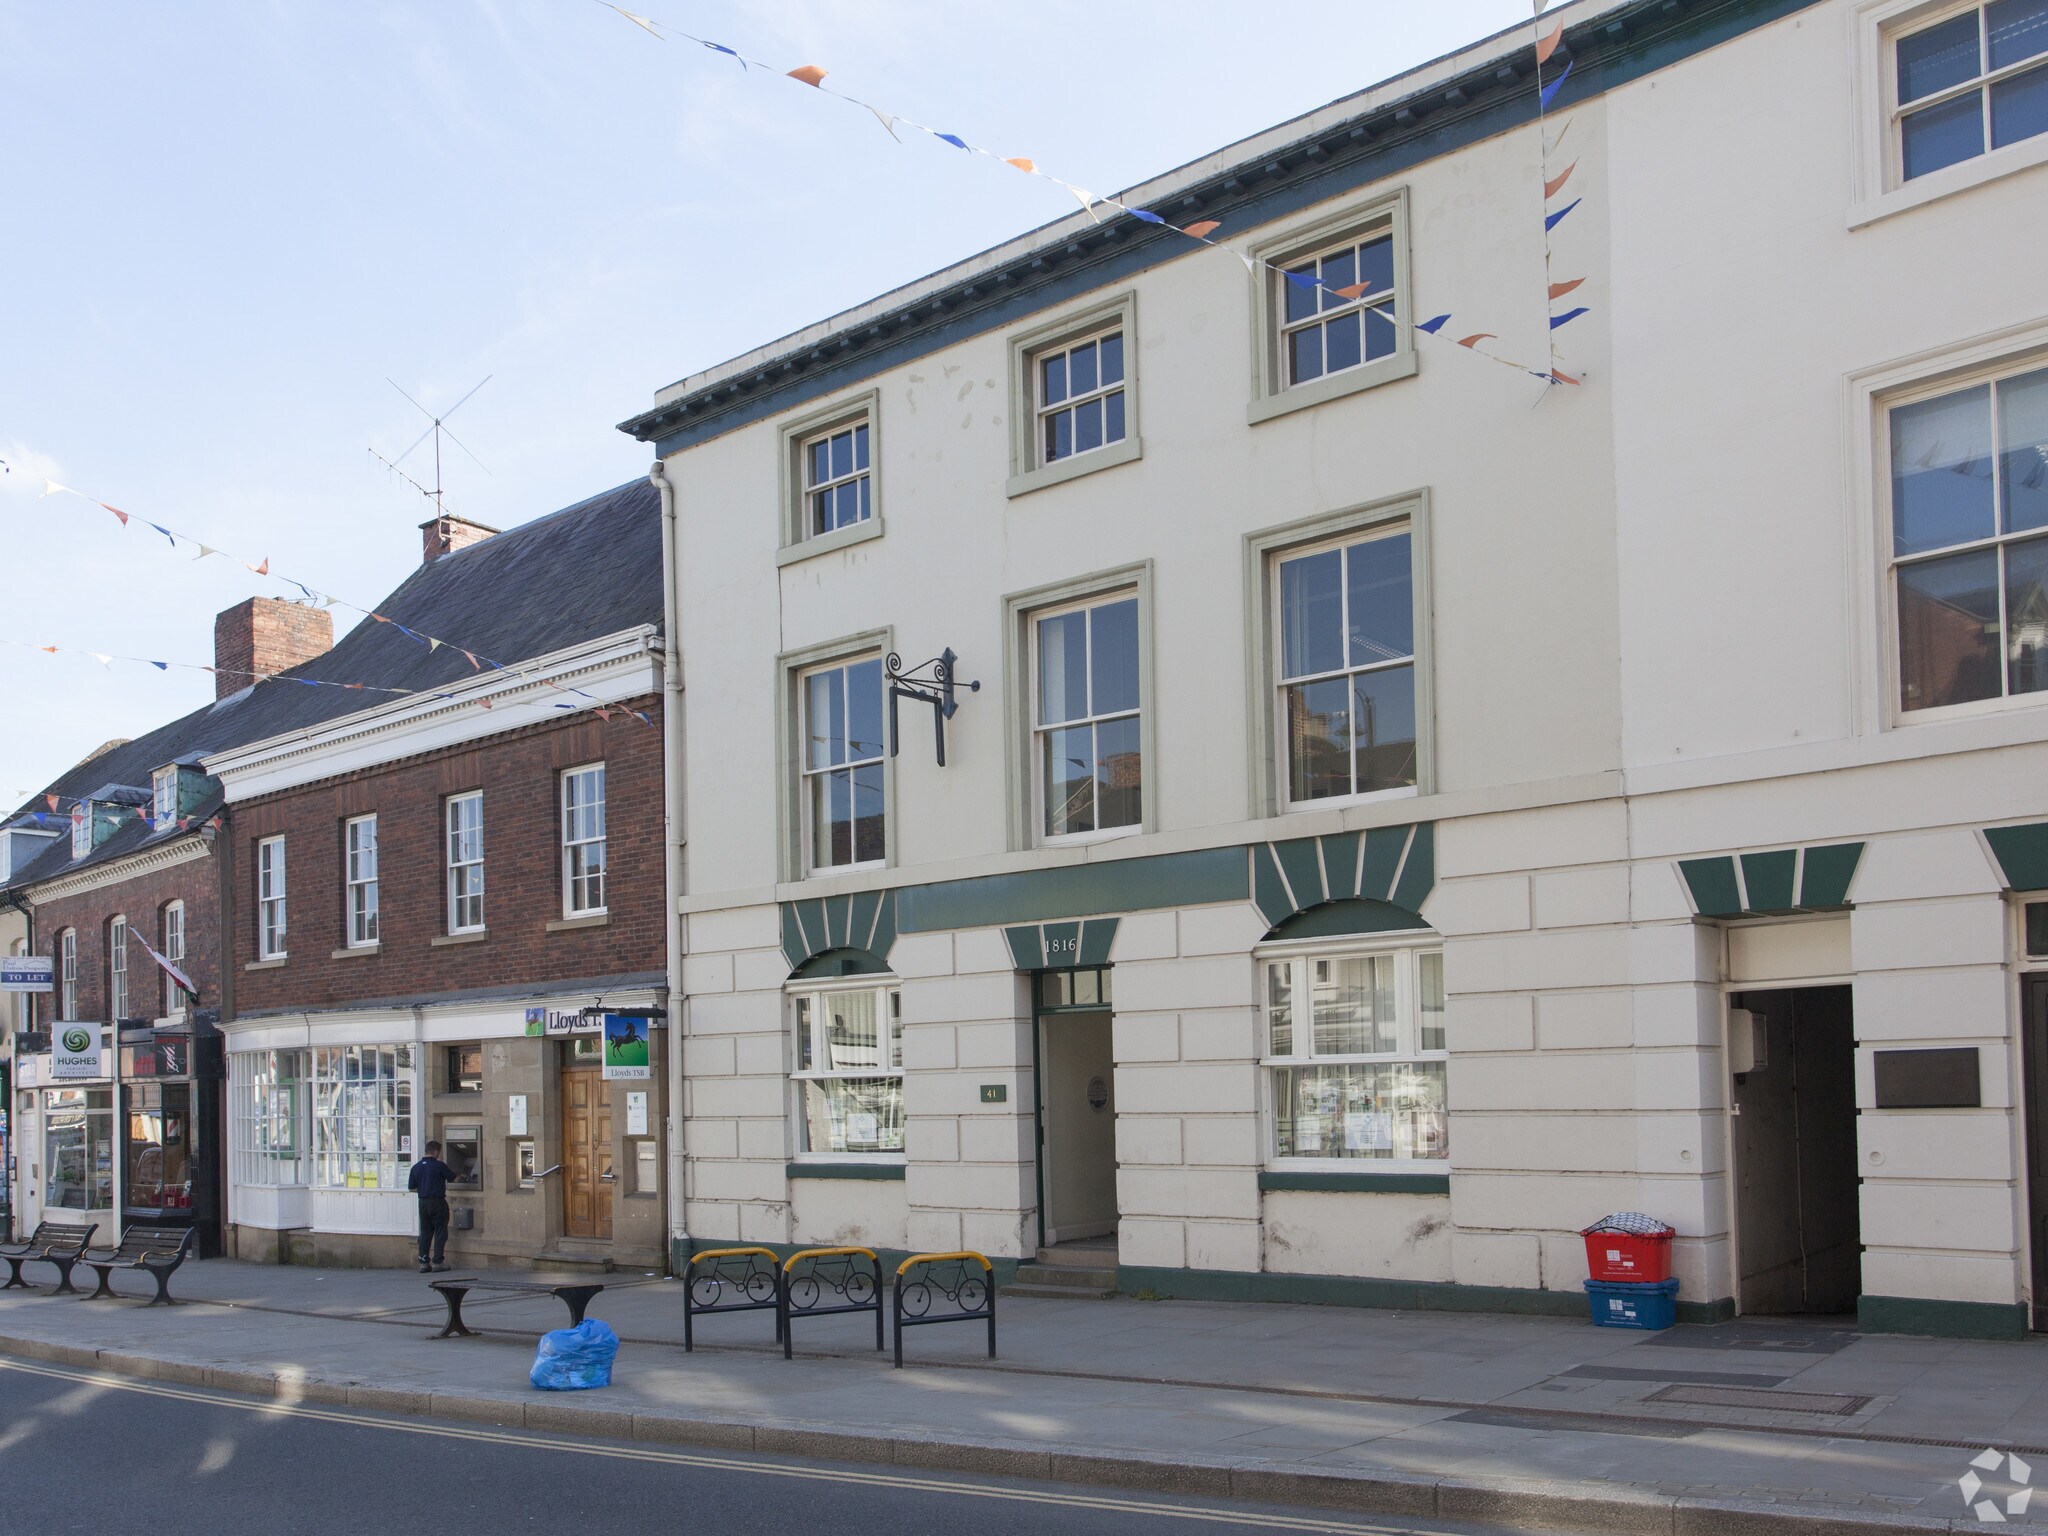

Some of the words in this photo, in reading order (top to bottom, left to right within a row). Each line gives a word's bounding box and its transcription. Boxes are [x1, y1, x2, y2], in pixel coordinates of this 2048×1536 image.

[1045, 938, 1076, 953] 1816
[549, 1010, 588, 1034] Lloyds
[57, 1057, 98, 1065] HUGHES
[611, 1068, 632, 1079] Lloyds
[633, 1069, 645, 1077] TSB
[986, 1089, 996, 1098] 41
